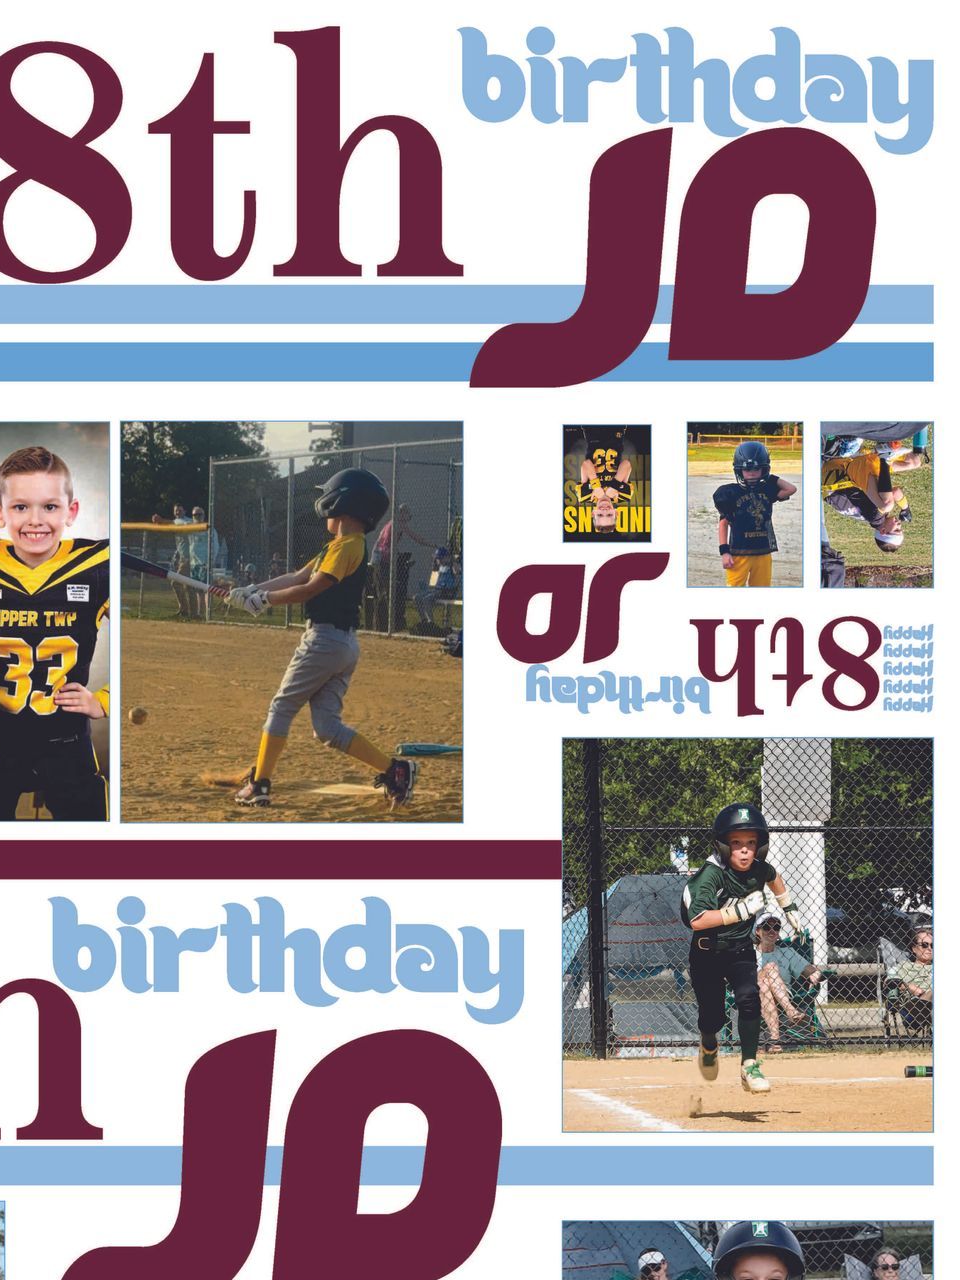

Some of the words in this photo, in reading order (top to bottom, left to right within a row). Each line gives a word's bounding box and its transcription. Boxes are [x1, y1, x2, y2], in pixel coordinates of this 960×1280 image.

[459, 27, 933, 154] birthday
[593, 448, 618, 473] 33
[564, 505, 651, 533] INDNS
[44, 611, 77, 627] TWP
[884, 625, 933, 641] Happy
[884, 643, 933, 659] Happy
[690, 616, 881, 716] 8th
[884, 660, 933, 676] Happy
[526, 664, 711, 714] birthday
[884, 679, 933, 694] Happy
[884, 696, 933, 712] Happy
[50, 896, 524, 1024] birthday
